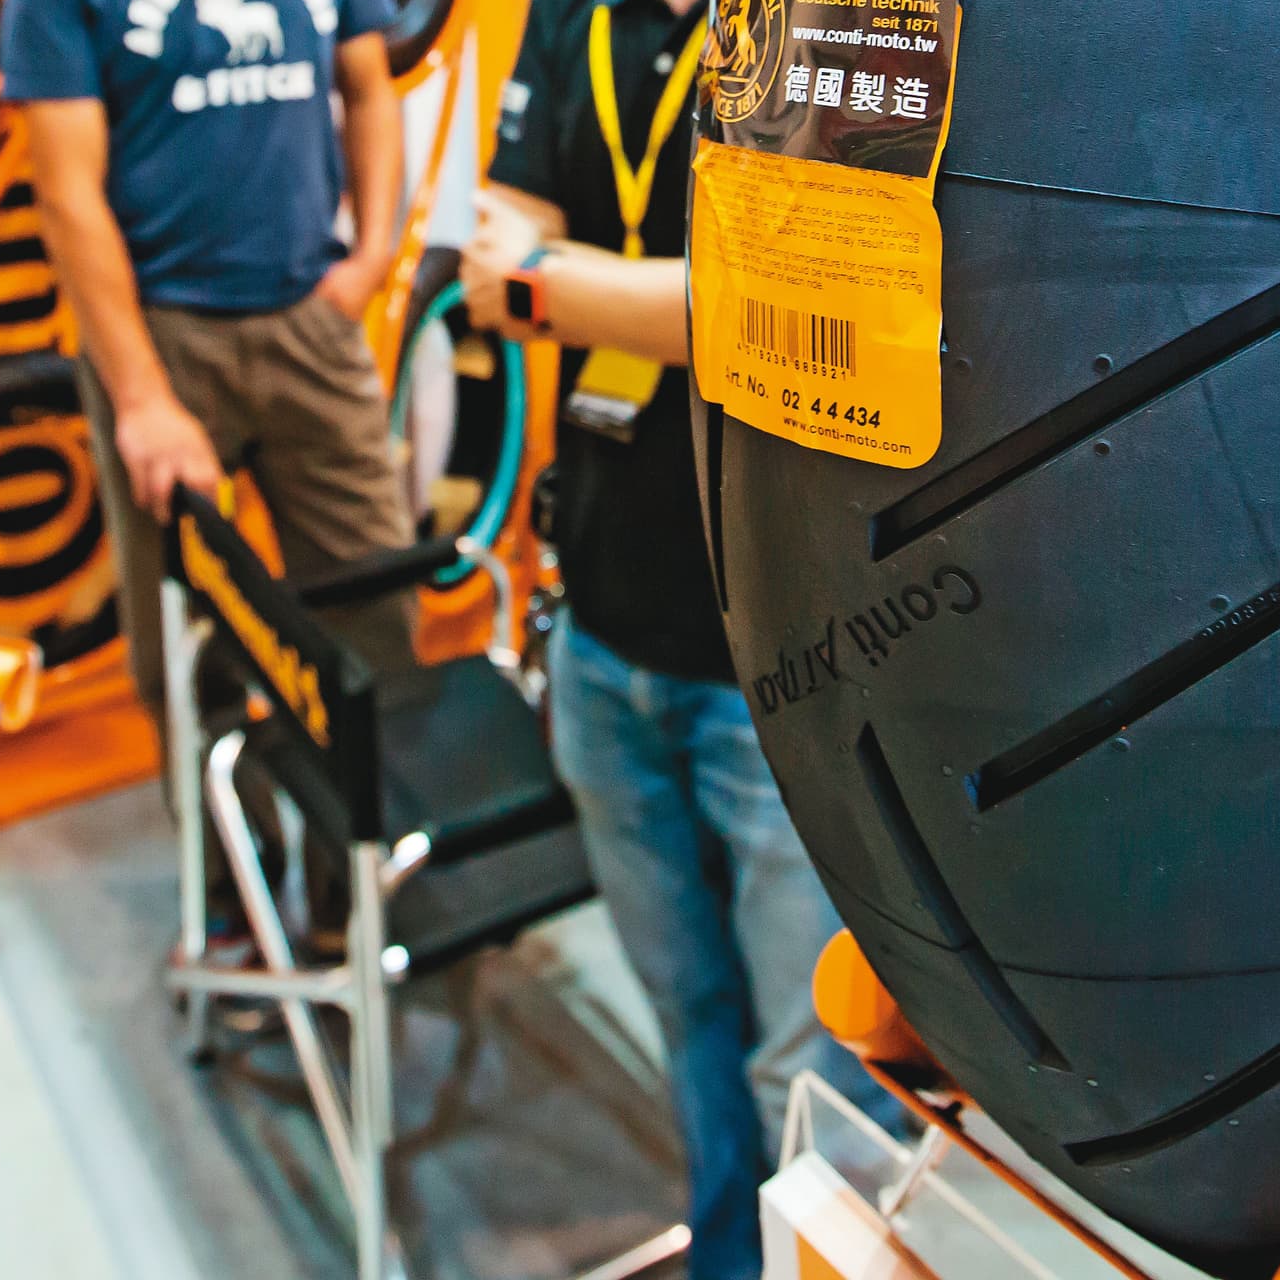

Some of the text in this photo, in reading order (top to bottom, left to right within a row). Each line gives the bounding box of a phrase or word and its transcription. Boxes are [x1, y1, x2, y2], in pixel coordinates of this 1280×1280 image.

[792, 27, 938, 54] www.conti-moto.tw
[871, 16, 938, 34] seit 1871
[784, 64, 930, 120] 德國製造
[747, 375, 769, 399] No.
[782, 389, 800, 410] 02
[783, 417, 912, 455] www.conti-moto.com
[845, 564, 982, 667] Conti
